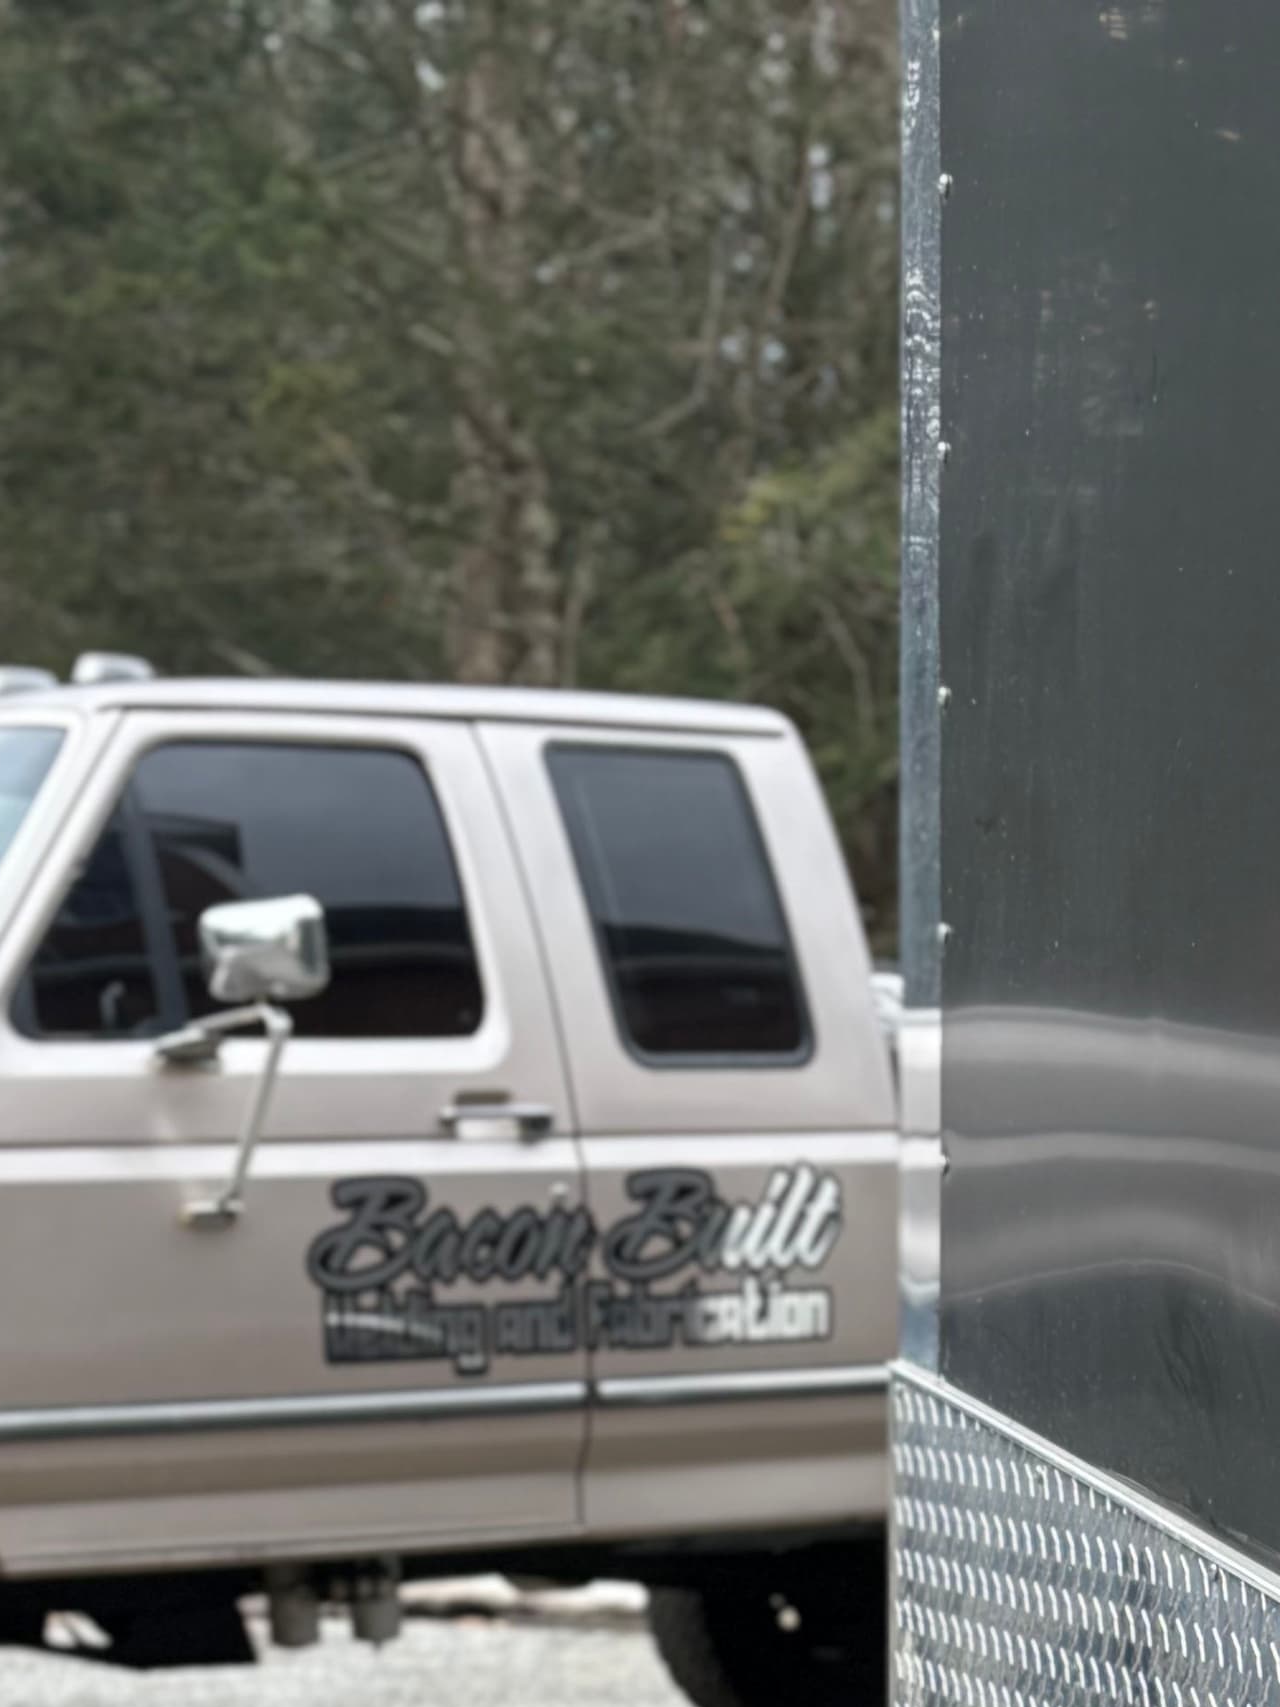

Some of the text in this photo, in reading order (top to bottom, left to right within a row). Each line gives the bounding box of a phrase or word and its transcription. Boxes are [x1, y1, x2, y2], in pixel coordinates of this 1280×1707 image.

[310, 1162, 841, 1292] Bacon Built
[494, 1281, 576, 1354] and
